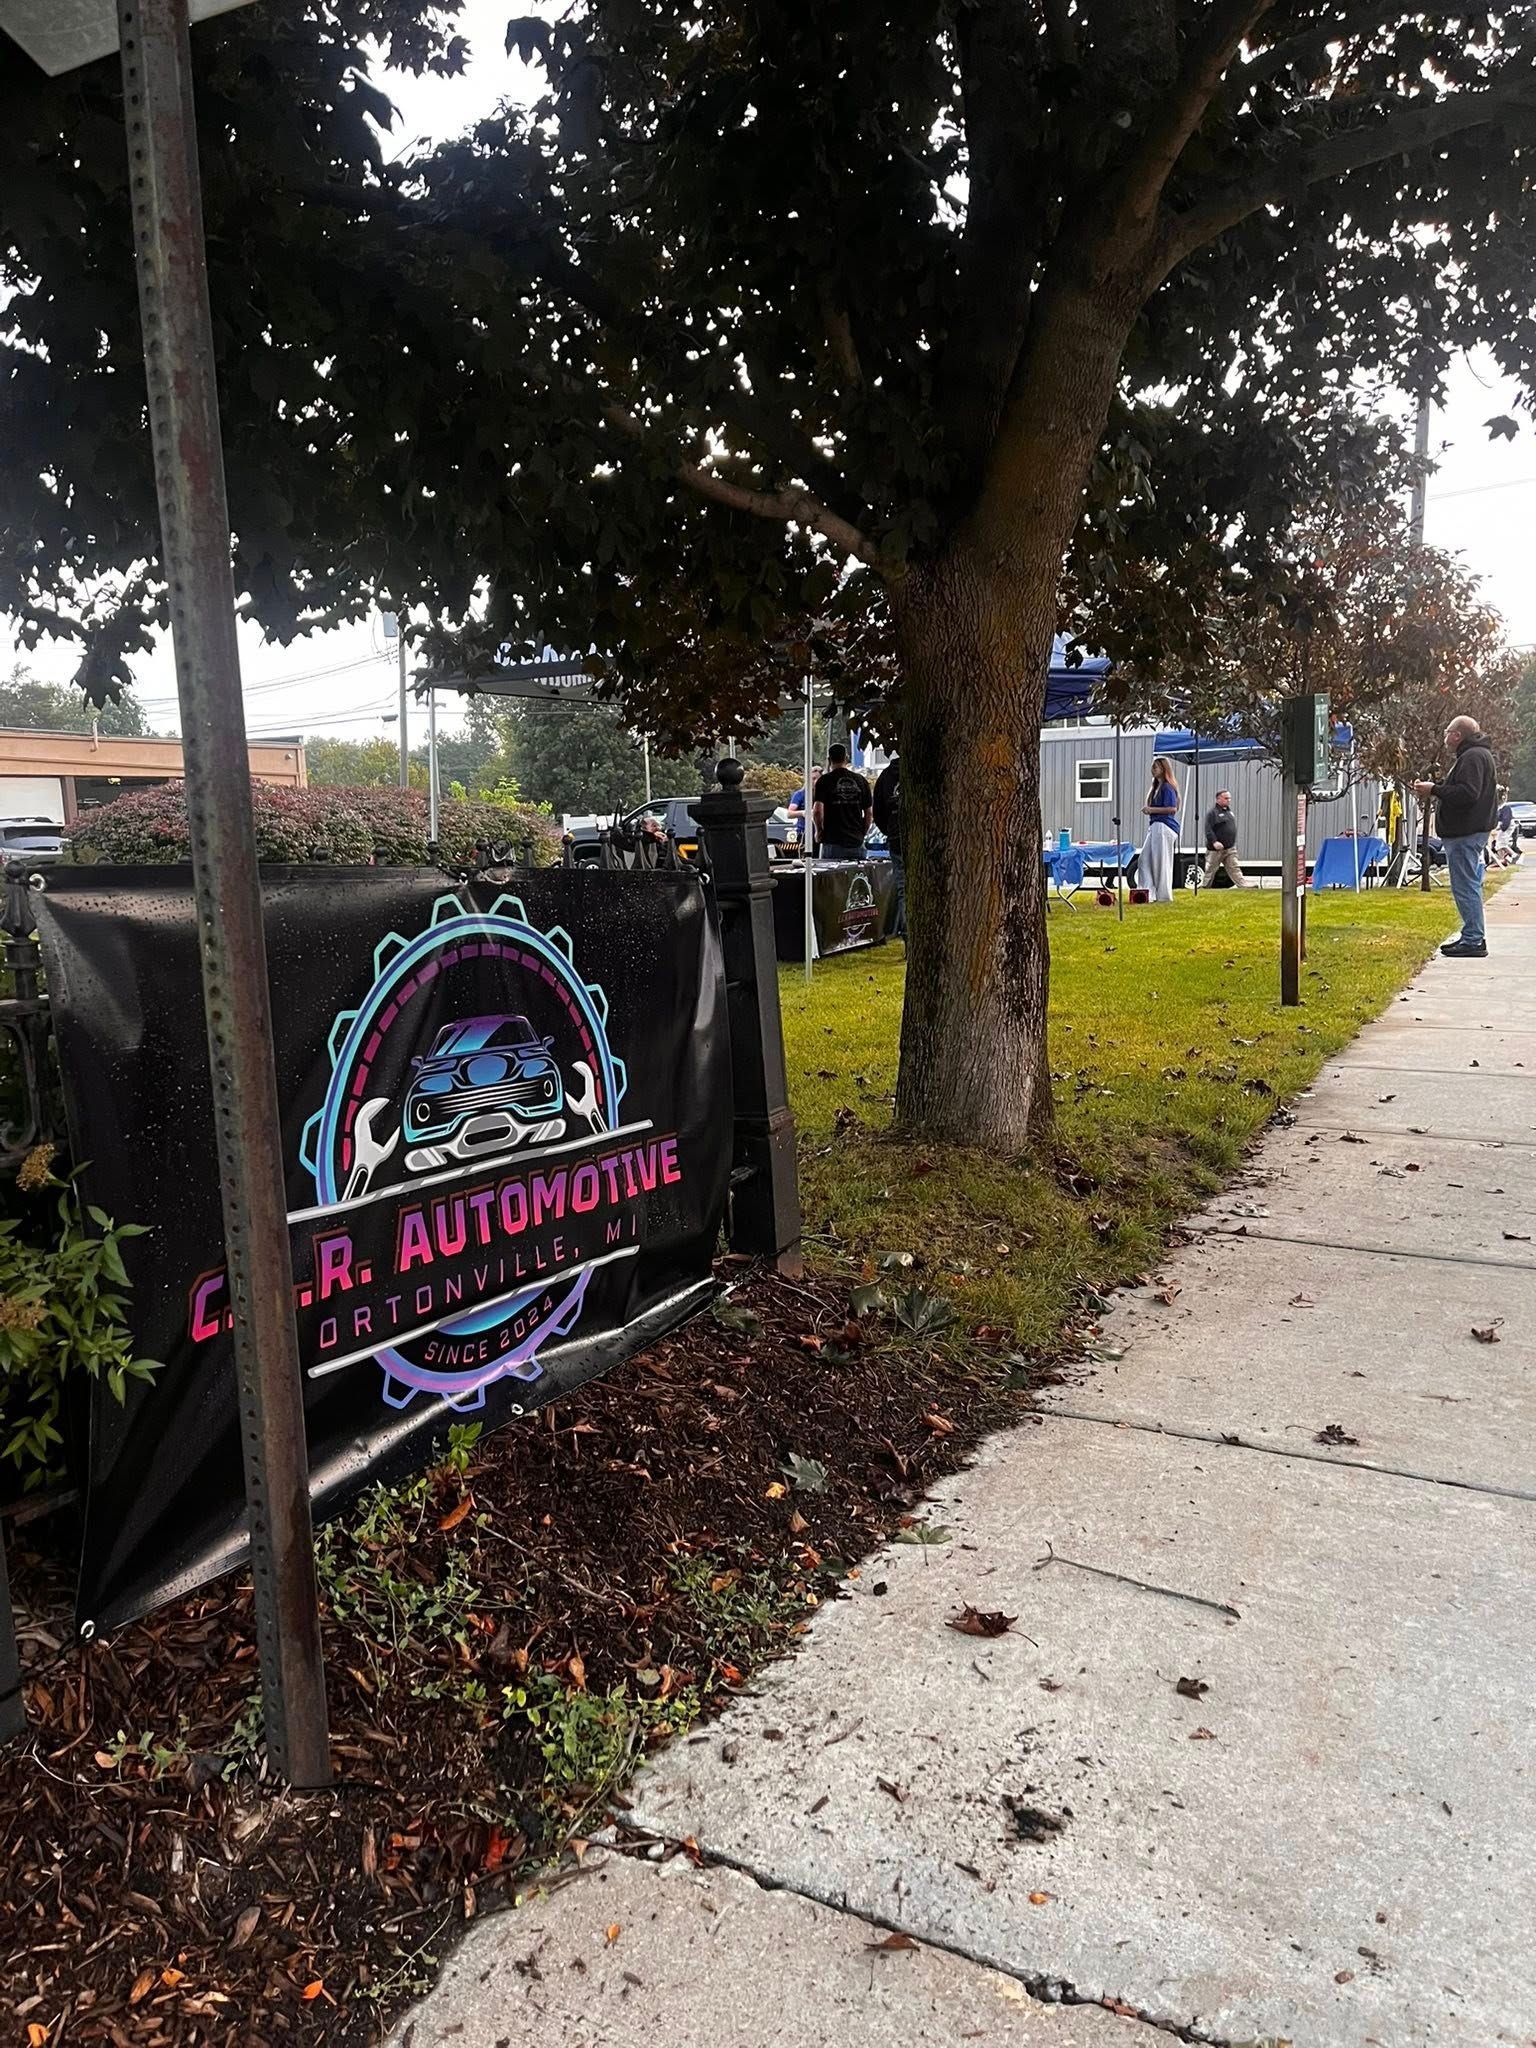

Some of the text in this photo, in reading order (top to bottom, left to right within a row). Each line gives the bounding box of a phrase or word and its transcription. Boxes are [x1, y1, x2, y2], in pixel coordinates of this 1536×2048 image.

[190, 1136, 682, 1344] C..R. AUTOMOTIVE
[319, 1213, 637, 1350] ORTONVILLE, MI
[424, 1295, 553, 1365] SINCE 2024
